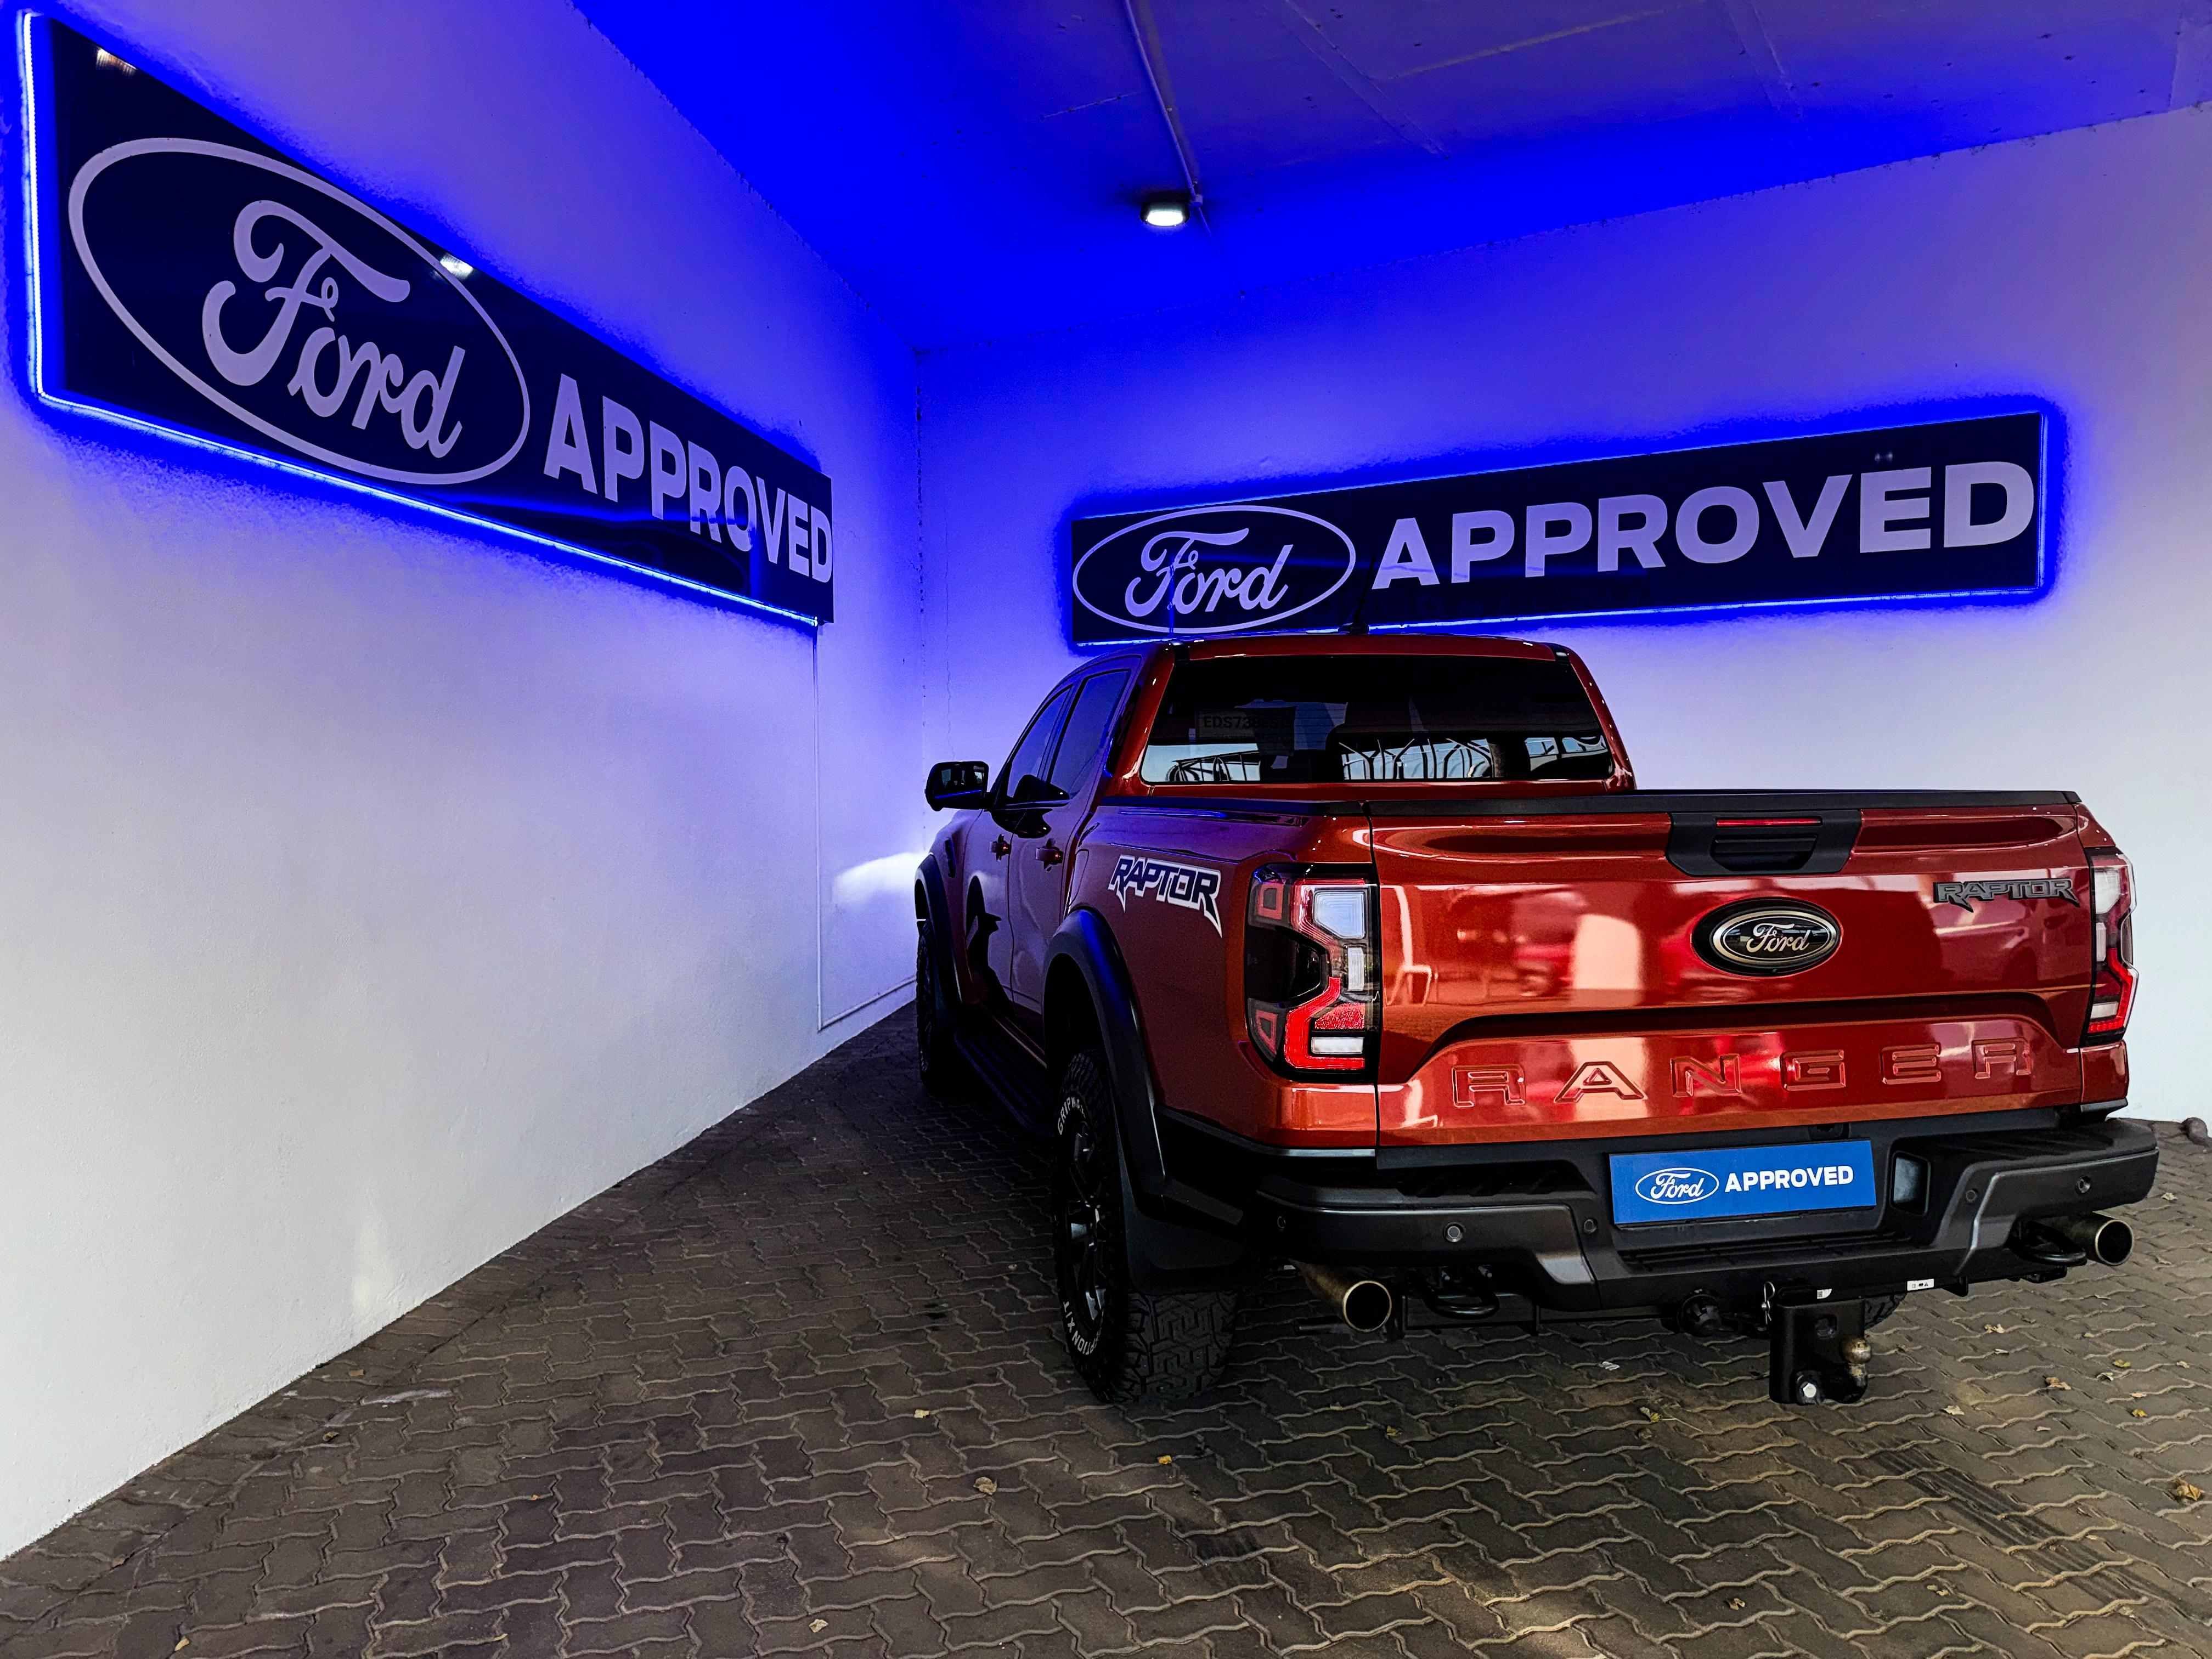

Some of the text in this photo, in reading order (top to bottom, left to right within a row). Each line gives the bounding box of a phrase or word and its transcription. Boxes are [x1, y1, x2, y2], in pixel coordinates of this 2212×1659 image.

[202, 200, 833, 584] Ford APPROVED
[1125, 461, 2035, 617] Ford APPROVED
[1108, 854, 1222, 938] RAPTOR
[1933, 878, 2080, 913] RAPTOR
[1746, 923, 1811, 952] Ford
[1452, 1037, 2032, 1108] RANGER
[1650, 1165, 1854, 1199] Ford APPROVED
